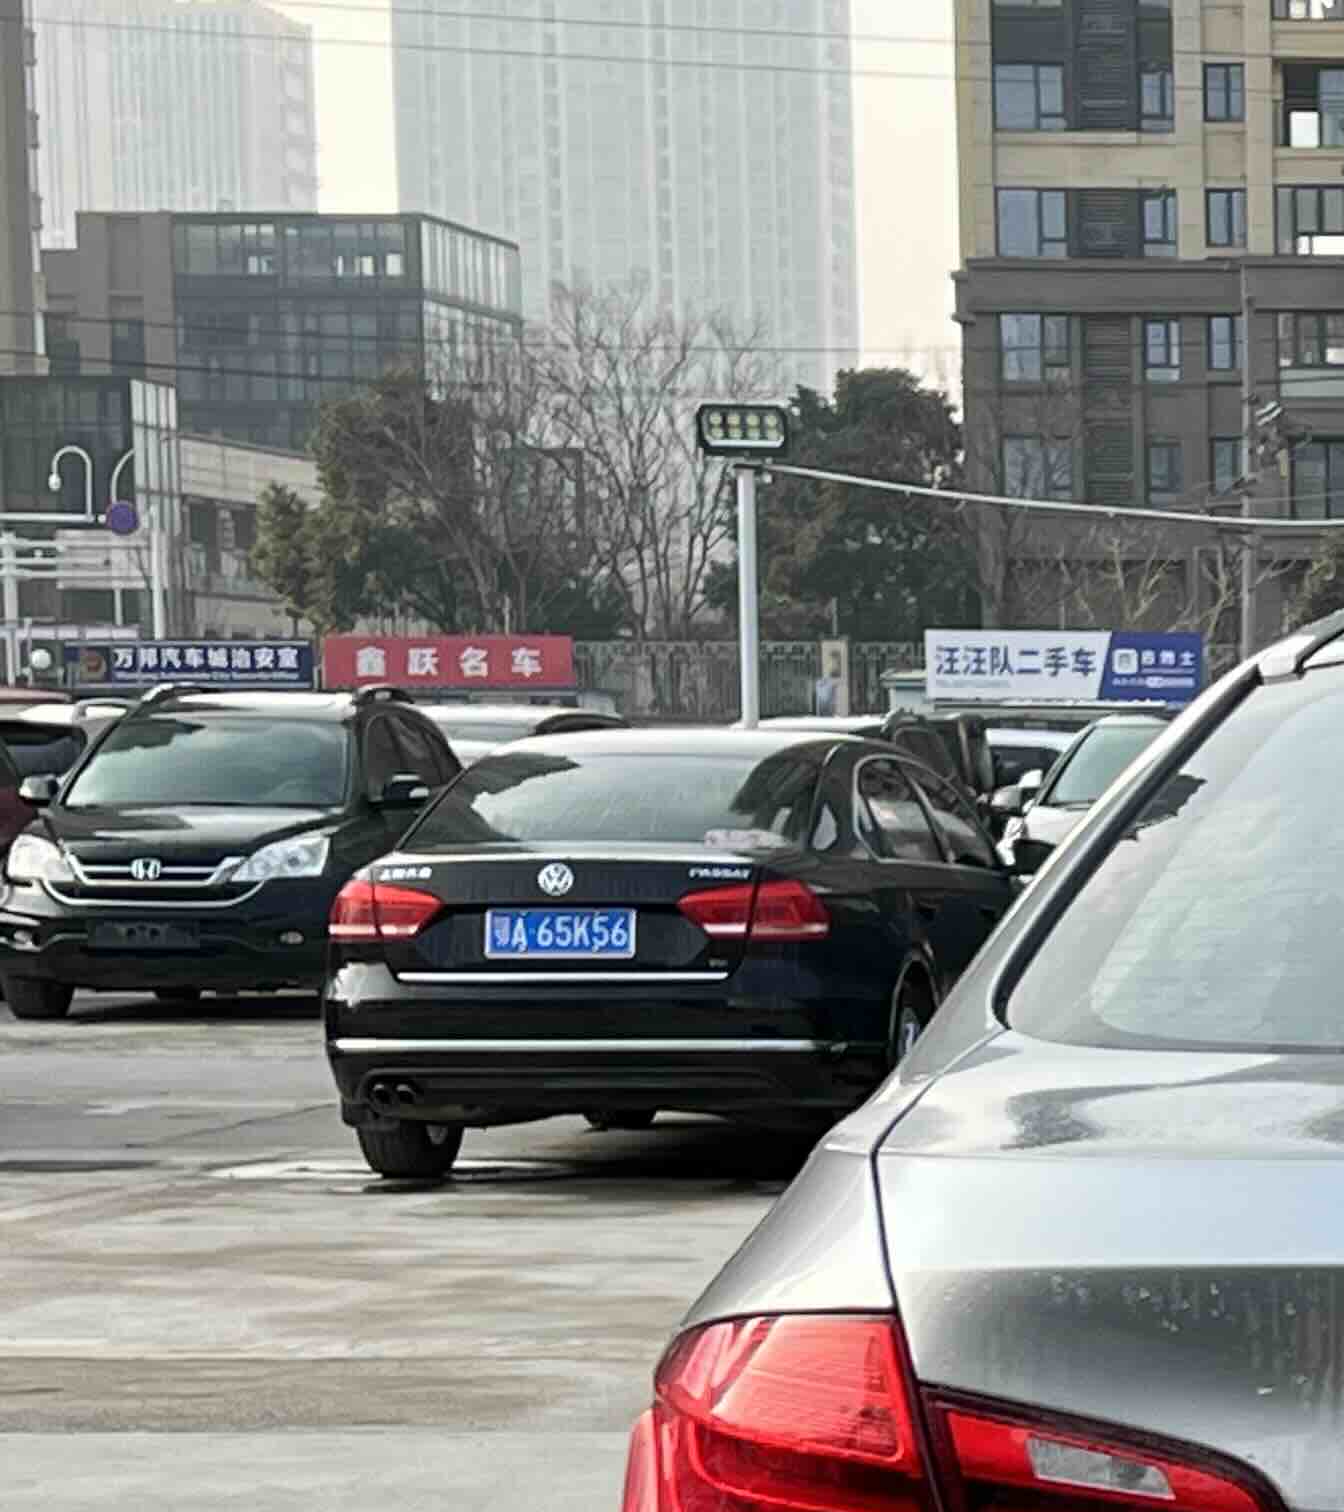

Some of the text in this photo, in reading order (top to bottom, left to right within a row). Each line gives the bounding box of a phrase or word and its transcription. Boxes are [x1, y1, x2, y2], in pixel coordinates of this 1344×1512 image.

[355, 645, 543, 678] 鑫跃名车
[935, 645, 1097, 677] 汪汪队二手车
